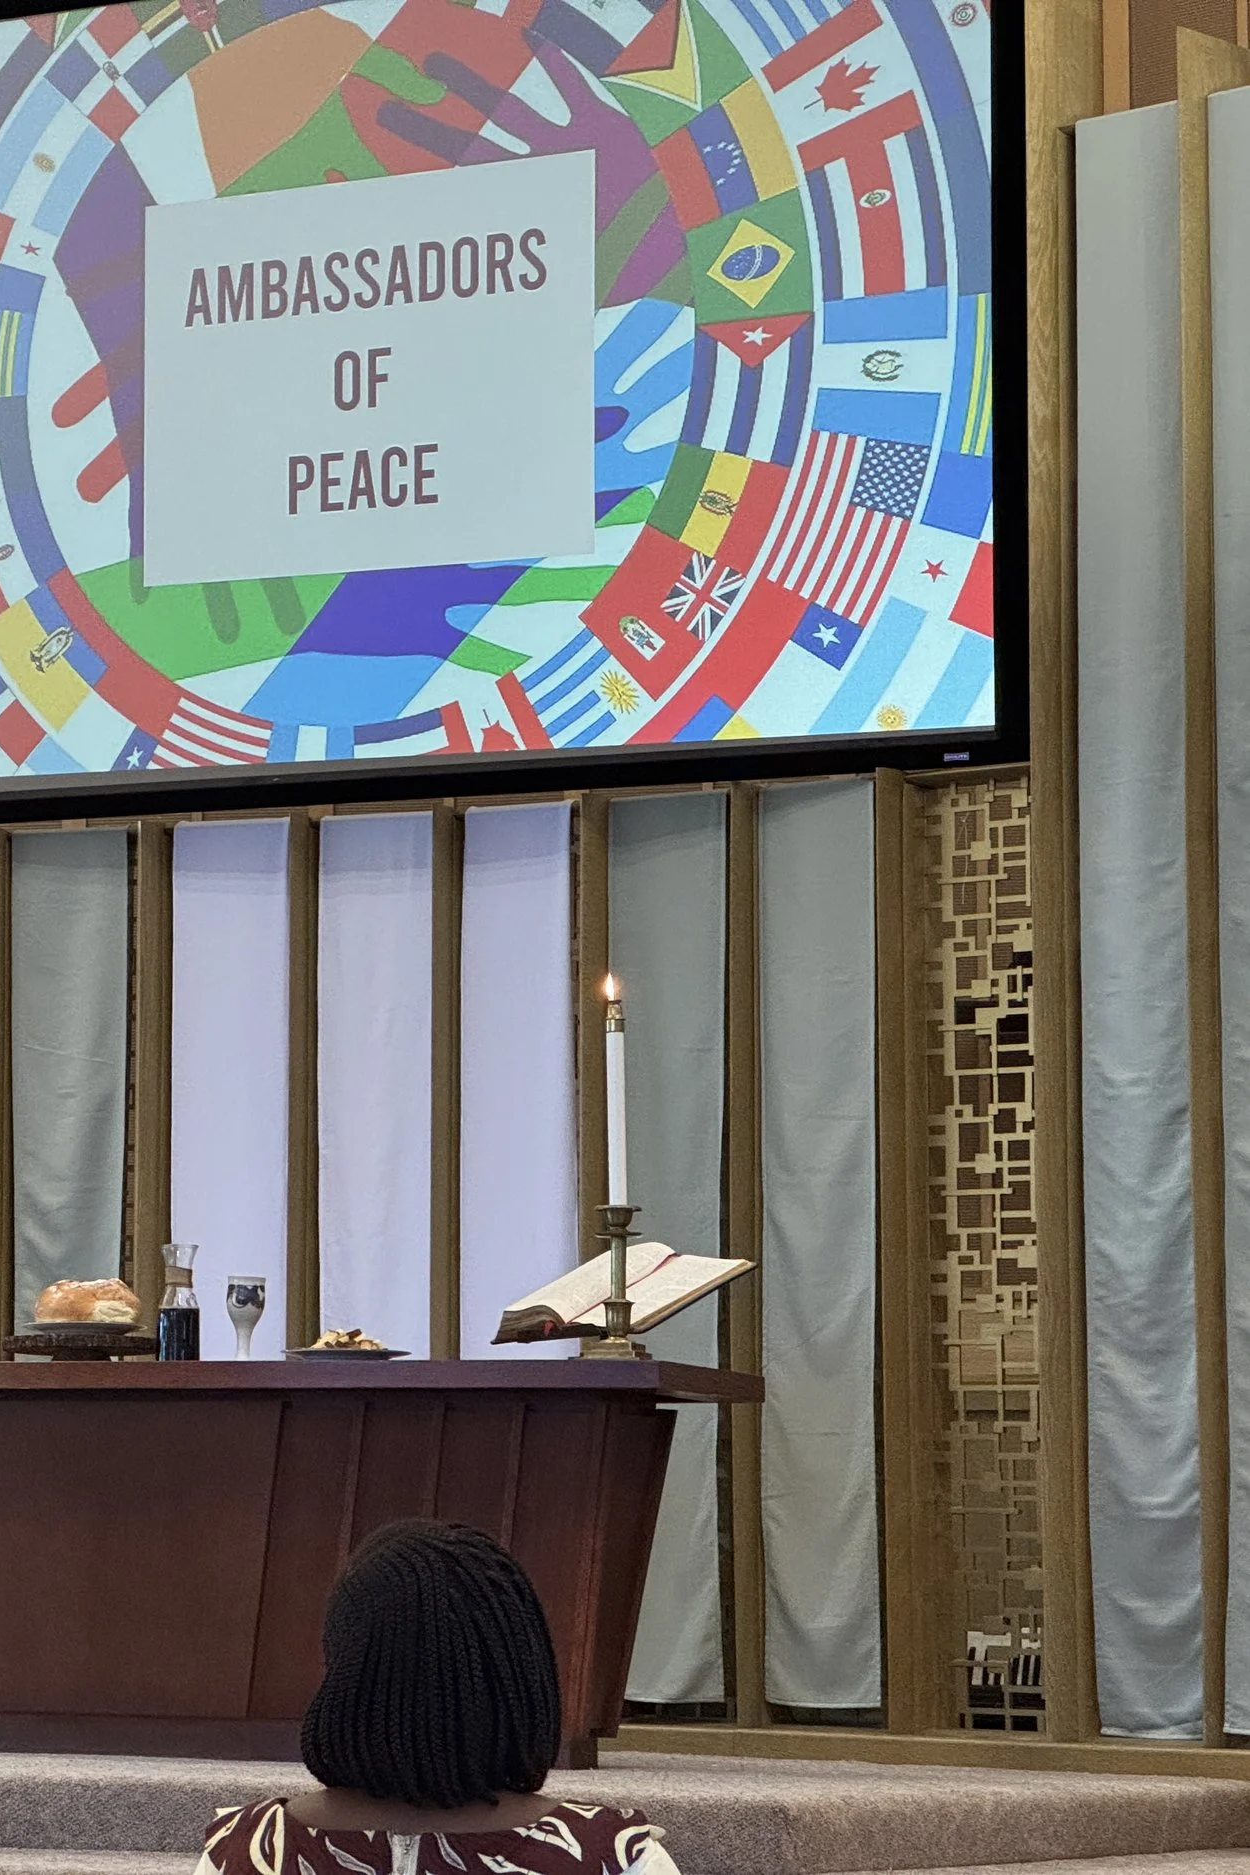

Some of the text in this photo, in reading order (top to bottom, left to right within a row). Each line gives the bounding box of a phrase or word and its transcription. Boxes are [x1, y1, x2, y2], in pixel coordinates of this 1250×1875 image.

[185, 228, 547, 327] AMBASSADORS
[334, 347, 391, 410] OF
[288, 444, 438, 514] PEACE
